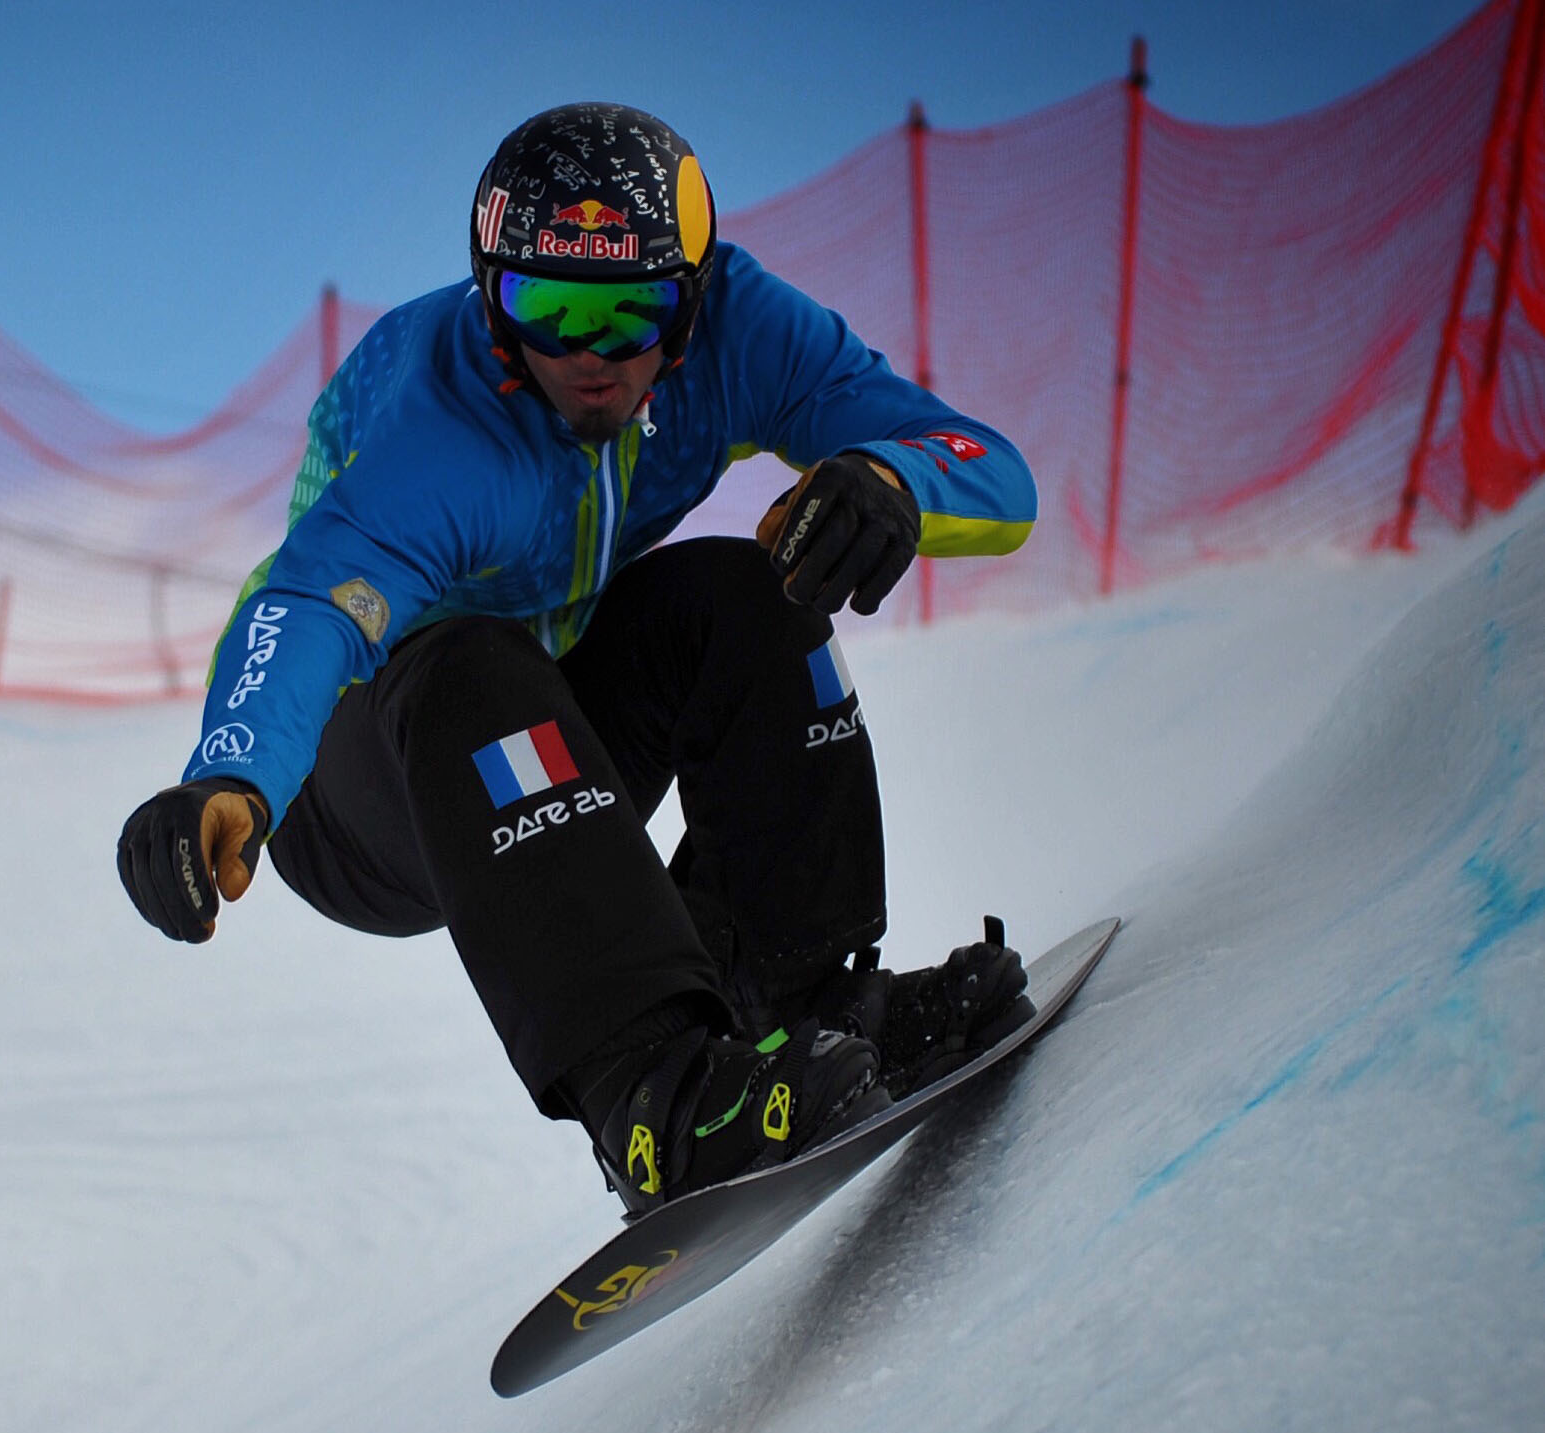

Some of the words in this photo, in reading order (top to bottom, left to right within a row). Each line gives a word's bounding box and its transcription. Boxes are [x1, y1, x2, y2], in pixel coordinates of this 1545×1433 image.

[537, 229, 587, 258] Red
[588, 232, 639, 260] Bull
[782, 499, 821, 564] DAKINE
[179, 837, 203, 910] DAKINE
